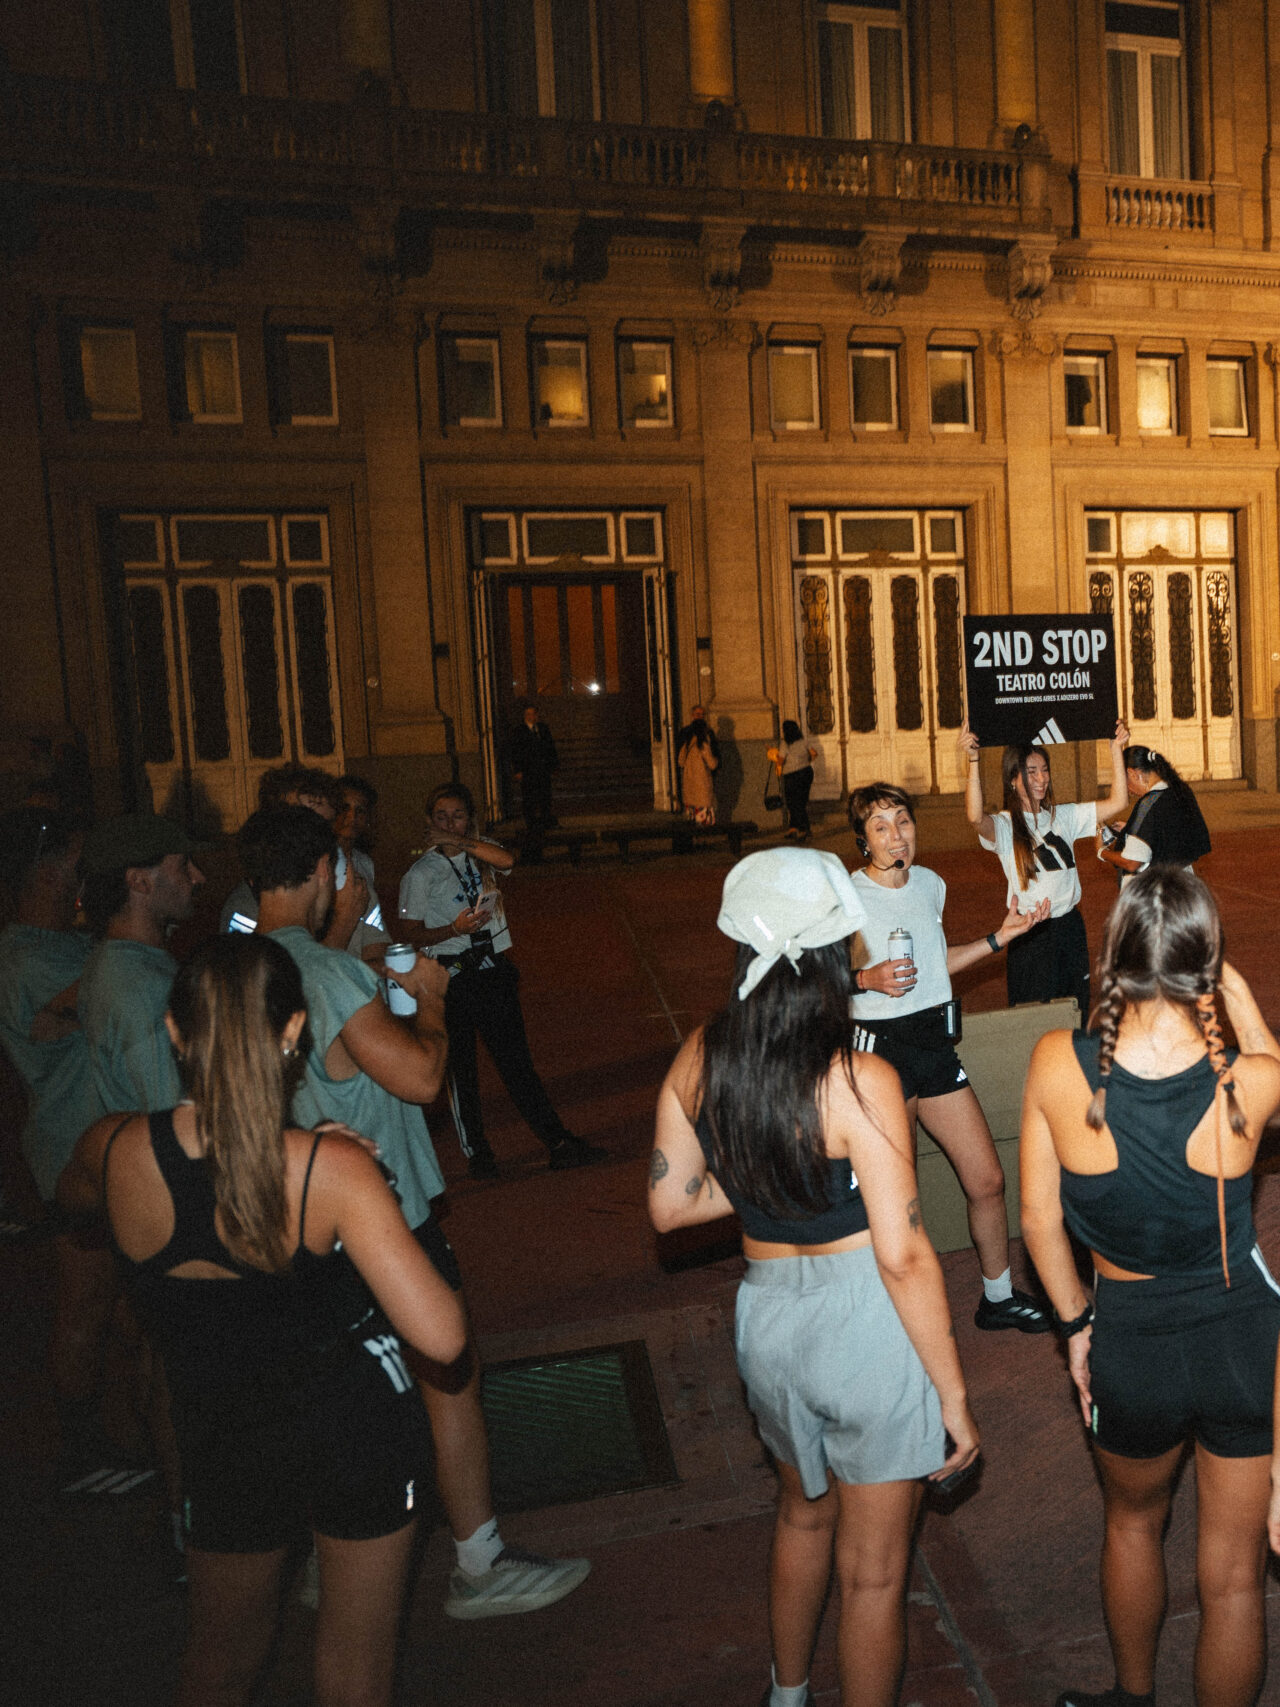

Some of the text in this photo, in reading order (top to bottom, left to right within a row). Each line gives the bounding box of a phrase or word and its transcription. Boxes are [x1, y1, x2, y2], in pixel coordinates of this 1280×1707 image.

[973, 629, 1107, 668] 2ND STOP
[996, 667, 1091, 692] TEATRO COLÓN
[995, 697, 1023, 705] DOWNTOWN
